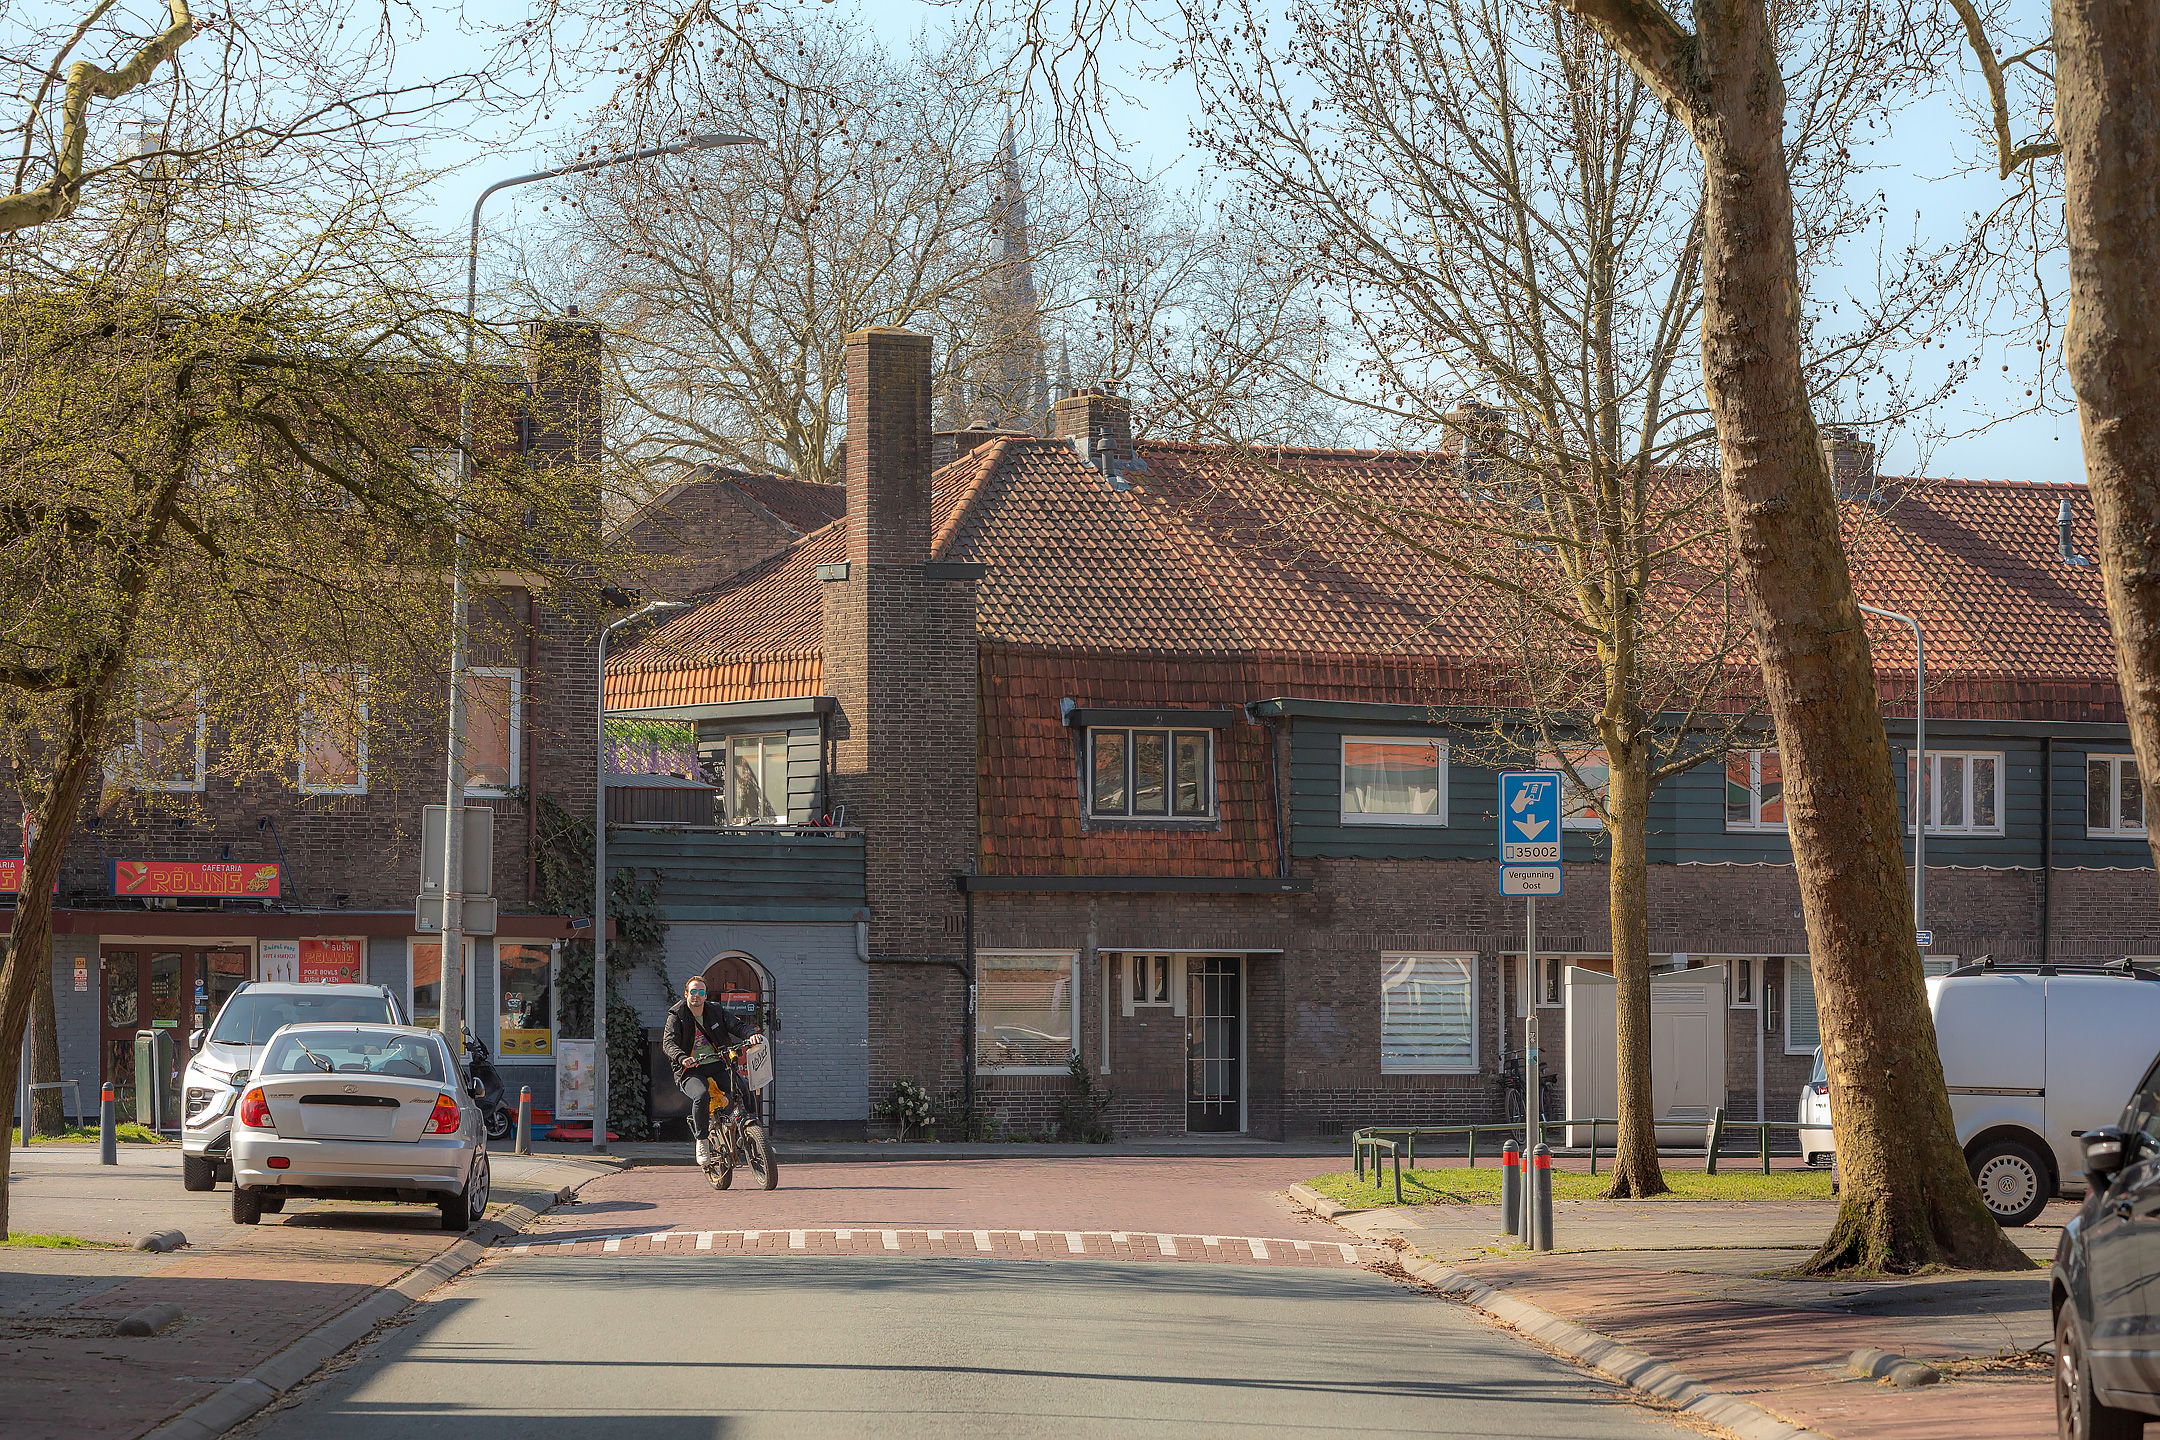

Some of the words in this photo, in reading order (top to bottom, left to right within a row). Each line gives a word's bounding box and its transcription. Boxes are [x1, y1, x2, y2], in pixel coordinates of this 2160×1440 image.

[1516, 846, 1557, 858] 35002
[202, 864, 242, 872] CAFETARIA
[149, 866, 243, 894] RÖLING
[1508, 870, 1554, 880] Vergunning
[1522, 882, 1541, 890] Oost
